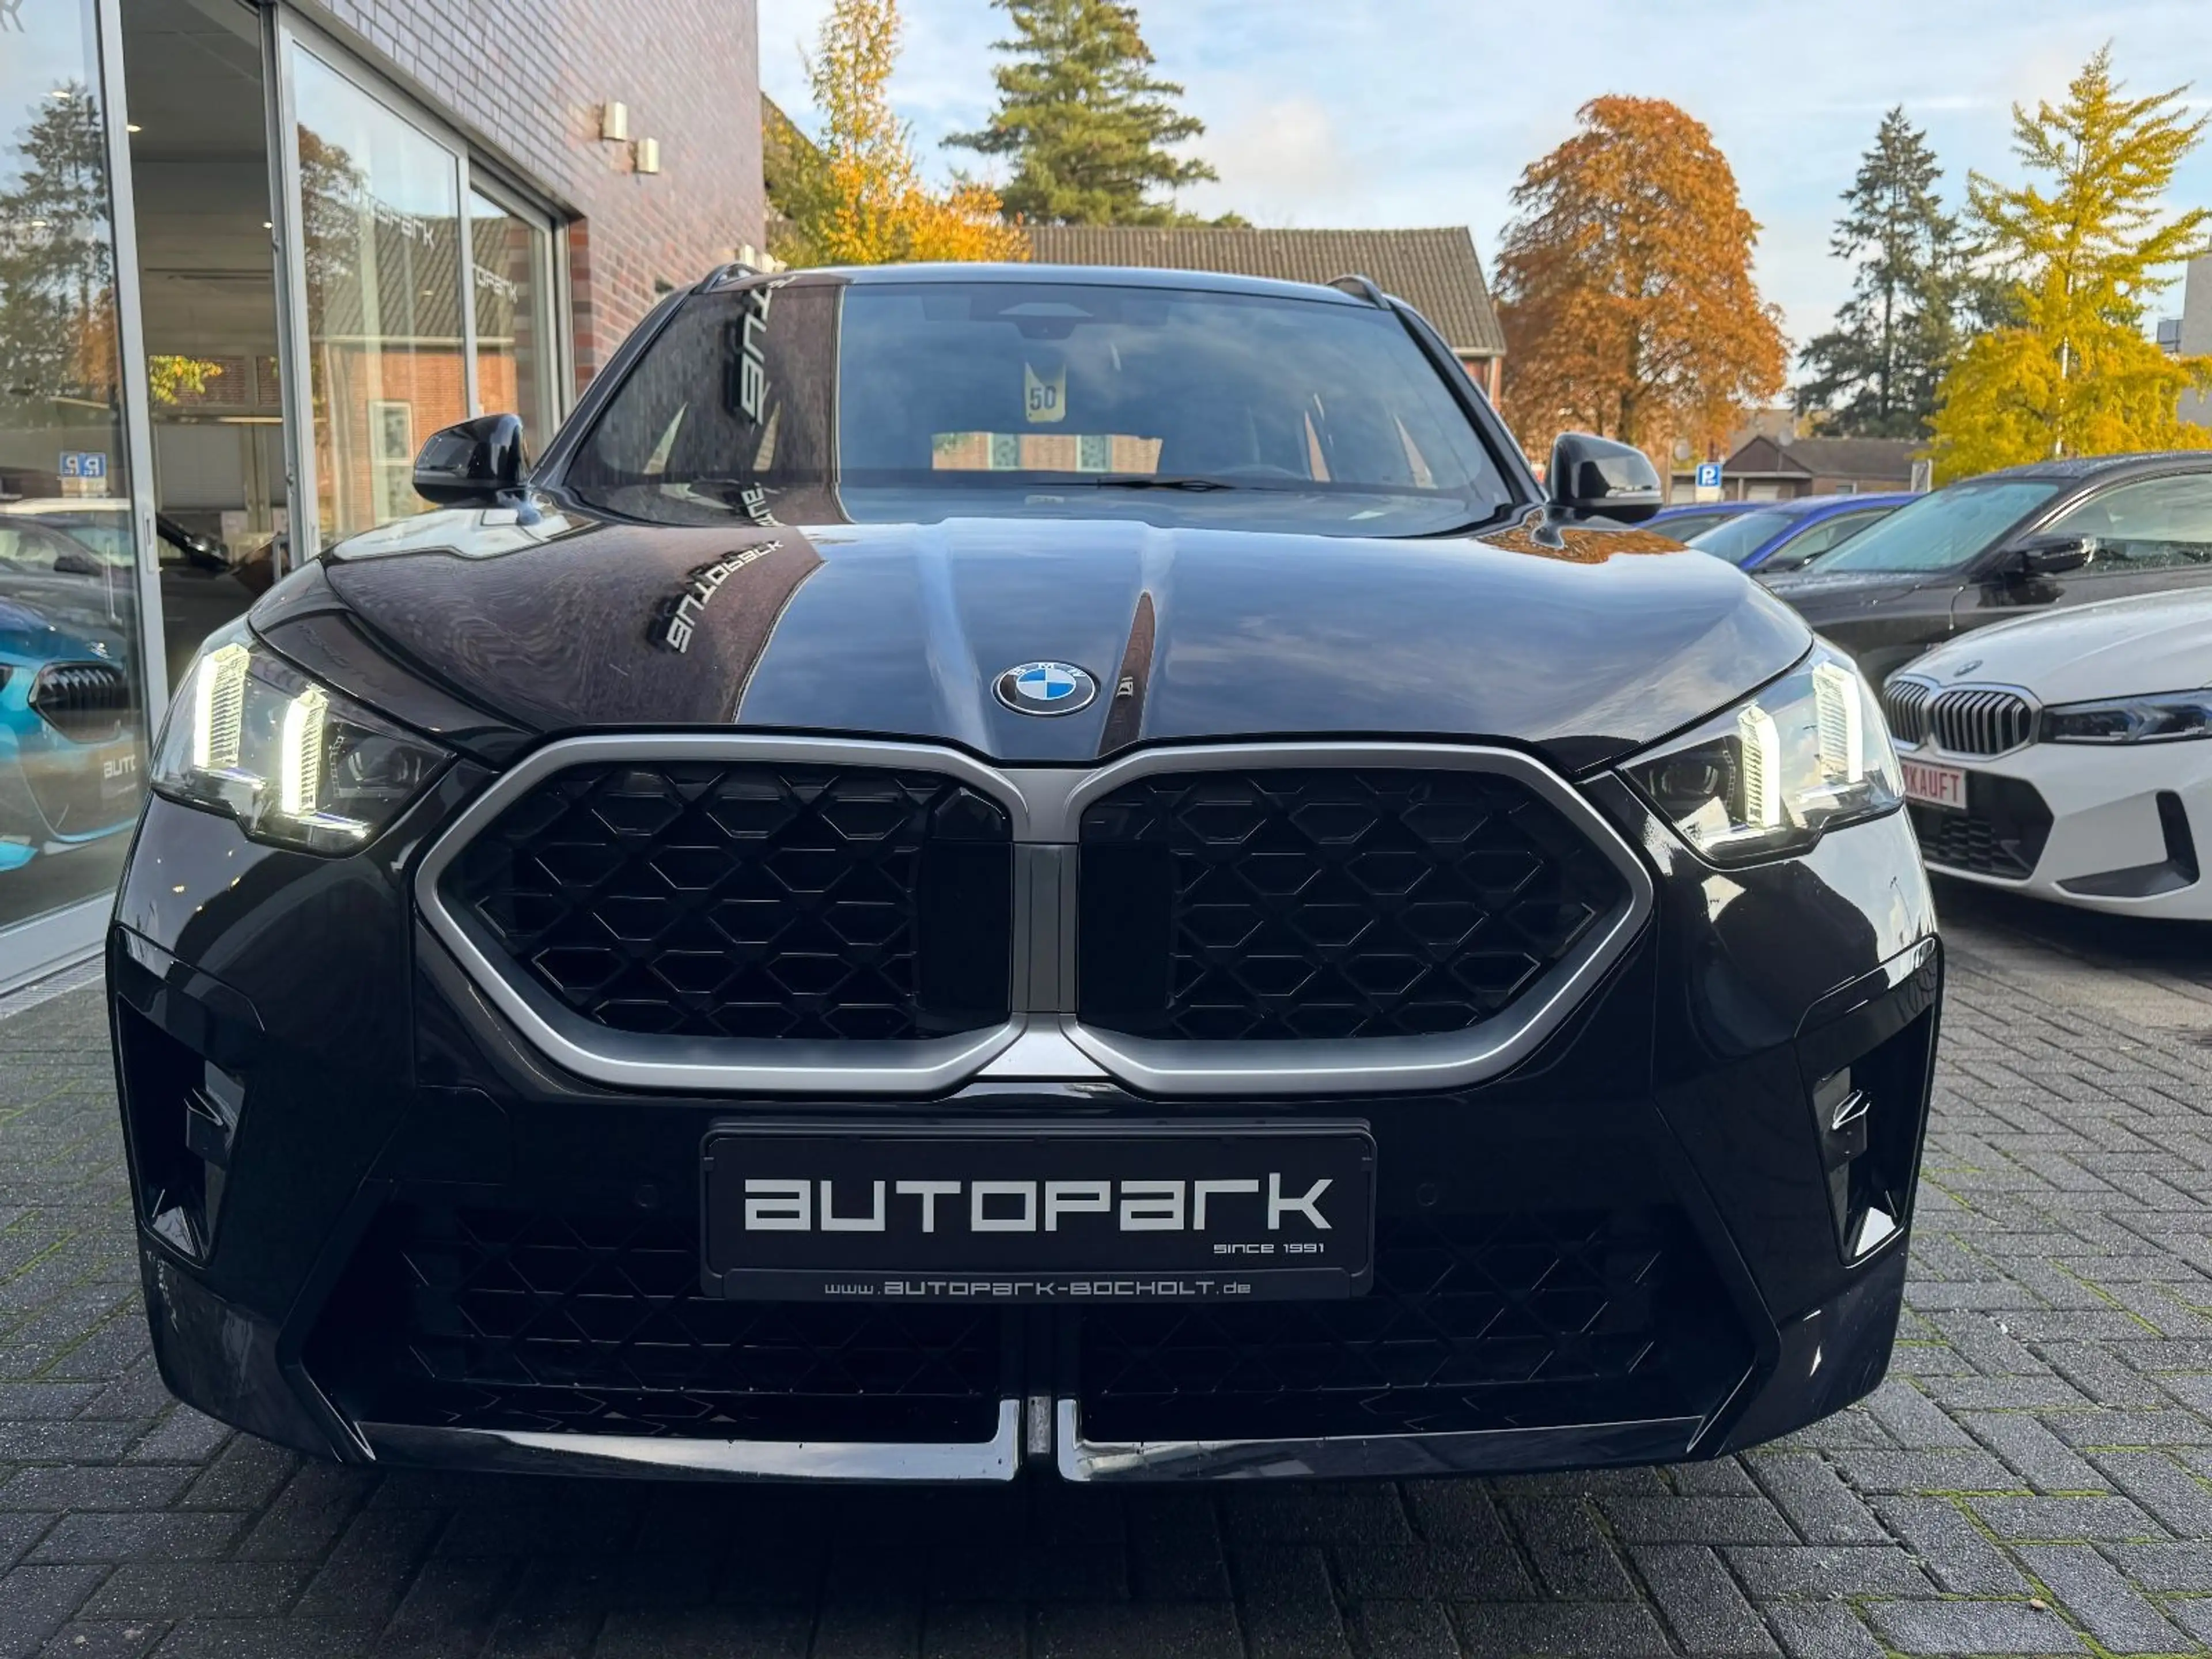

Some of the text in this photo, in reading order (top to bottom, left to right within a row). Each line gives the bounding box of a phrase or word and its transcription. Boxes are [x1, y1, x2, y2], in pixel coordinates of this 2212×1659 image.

[1030, 385, 1056, 410] 50
[1702, 465, 1716, 485] P
[1214, 1243, 1325, 1253] since 1991
